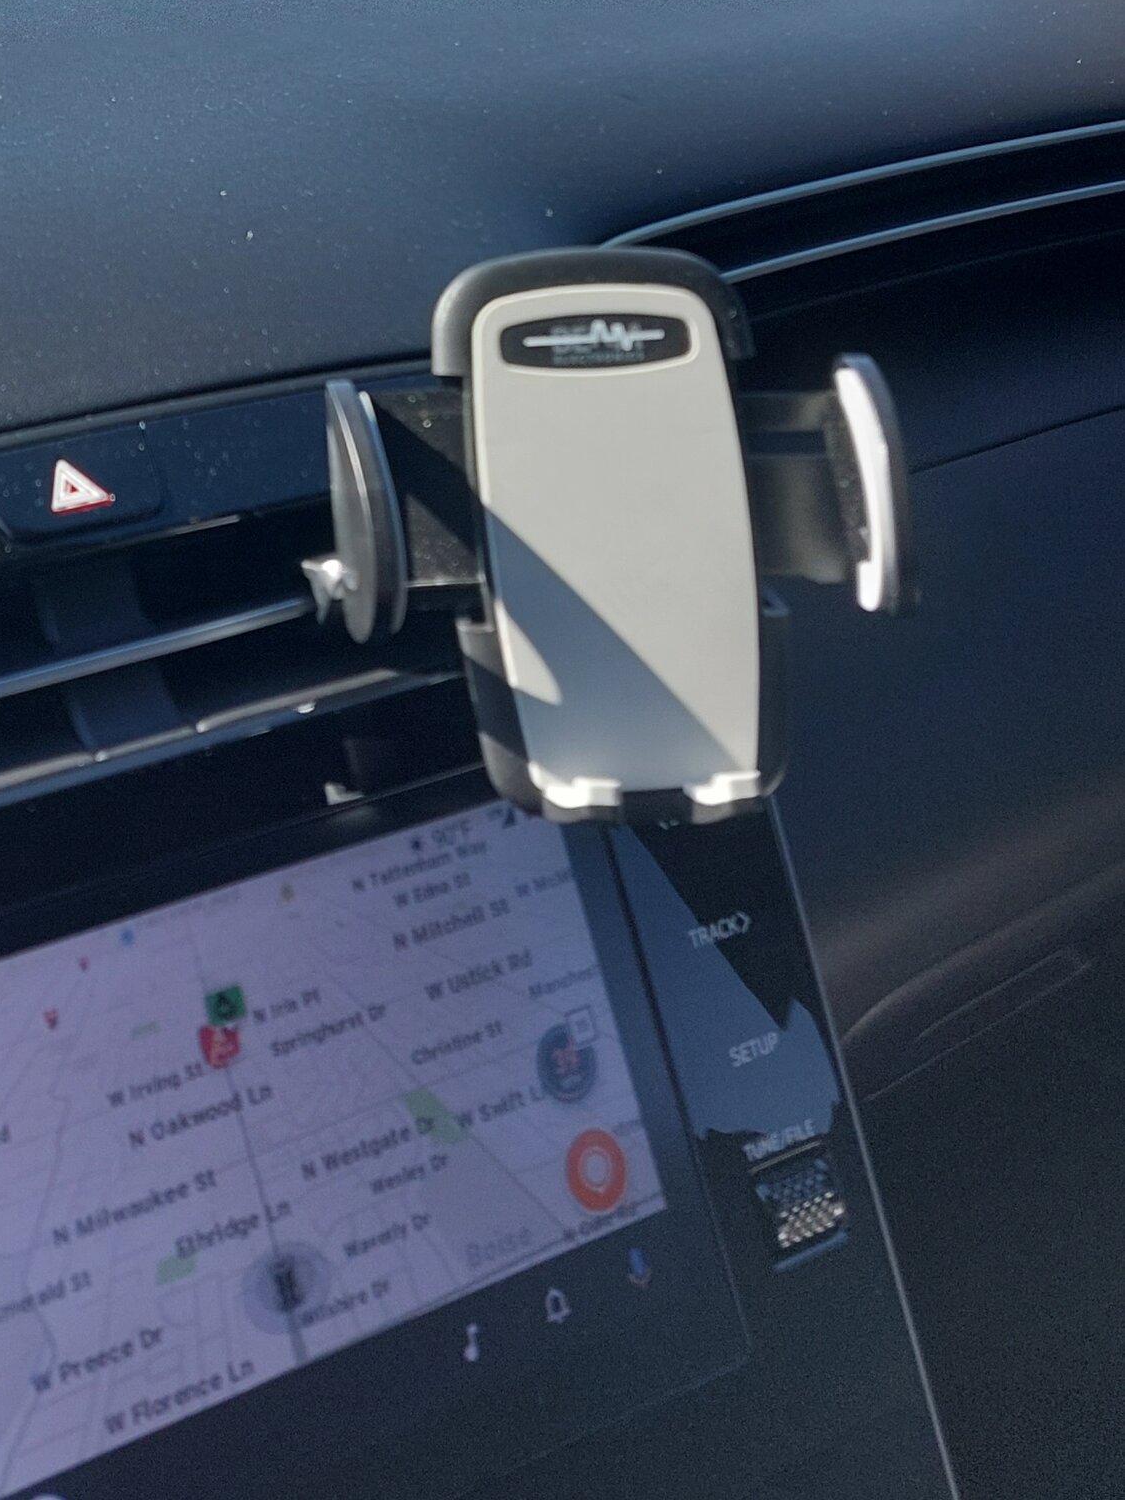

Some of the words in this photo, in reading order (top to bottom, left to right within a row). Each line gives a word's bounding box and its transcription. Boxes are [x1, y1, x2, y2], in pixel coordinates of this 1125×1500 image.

[688, 912, 743, 949] TRACK
[728, 1032, 778, 1068] SETUP
[128, 1128, 145, 1147] N
[150, 1090, 243, 1141] Oakwood
[300, 1160, 317, 1181] N
[321, 1127, 411, 1171] Westgate
[415, 1115, 436, 1136] Dr
[53, 1226, 70, 1245] N
[75, 1182, 190, 1238] Milwaukee
[193, 1168, 217, 1192] St
[30, 1370, 53, 1393] W
[139, 1326, 163, 1350] Dr
[104, 1412, 125, 1435] W
[131, 1372, 223, 1426] Florence
[226, 1359, 256, 1384] Ln
